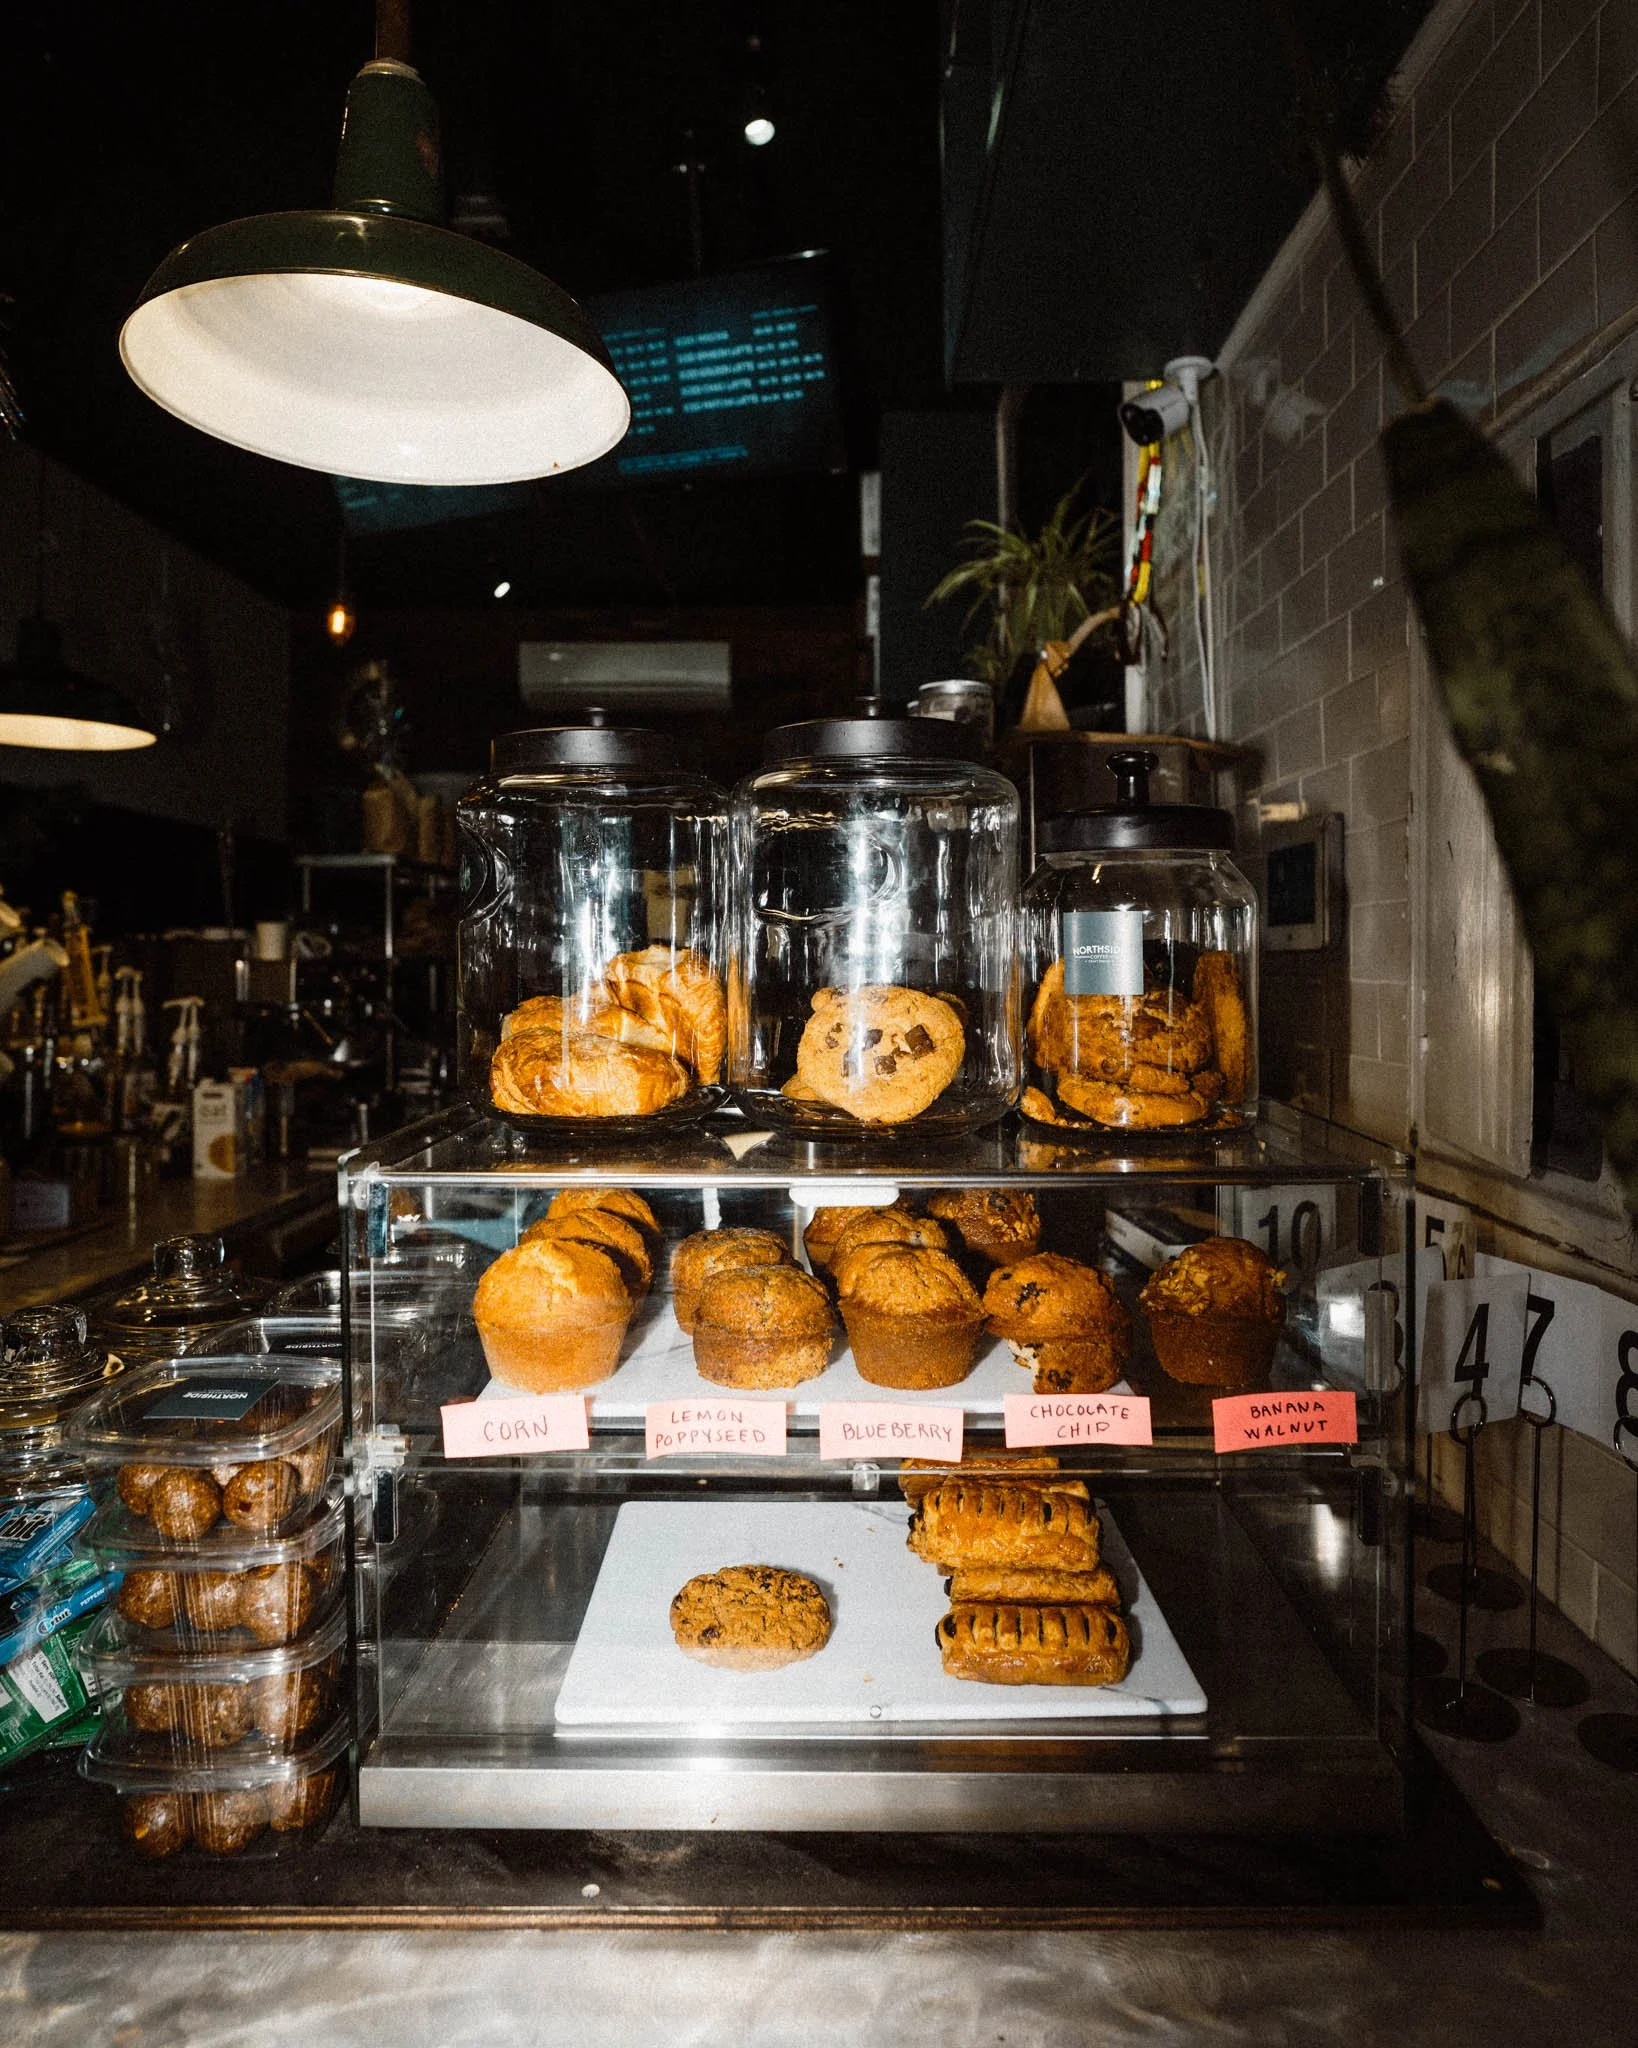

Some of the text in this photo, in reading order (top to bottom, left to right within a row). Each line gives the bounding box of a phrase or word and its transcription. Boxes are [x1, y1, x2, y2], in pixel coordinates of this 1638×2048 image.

[1073, 945, 1122, 956] NORTHSID
[1258, 1201, 1321, 1267] 10
[1521, 1293, 1555, 1385] 7
[1454, 1303, 1489, 1400] 4
[182, 1391, 248, 1399] NORTHSIDE
[671, 1409, 743, 1424] LEMON
[1030, 1403, 1130, 1419] CHOCOLATE
[1250, 1401, 1325, 1419] BANANA
[483, 1415, 548, 1442] CORN
[842, 1422, 952, 1442] BLUEBERRY
[1057, 1421, 1110, 1438] CHIP
[1244, 1420, 1328, 1439] WALNUT
[655, 1429, 766, 1448] POPPYSEED
